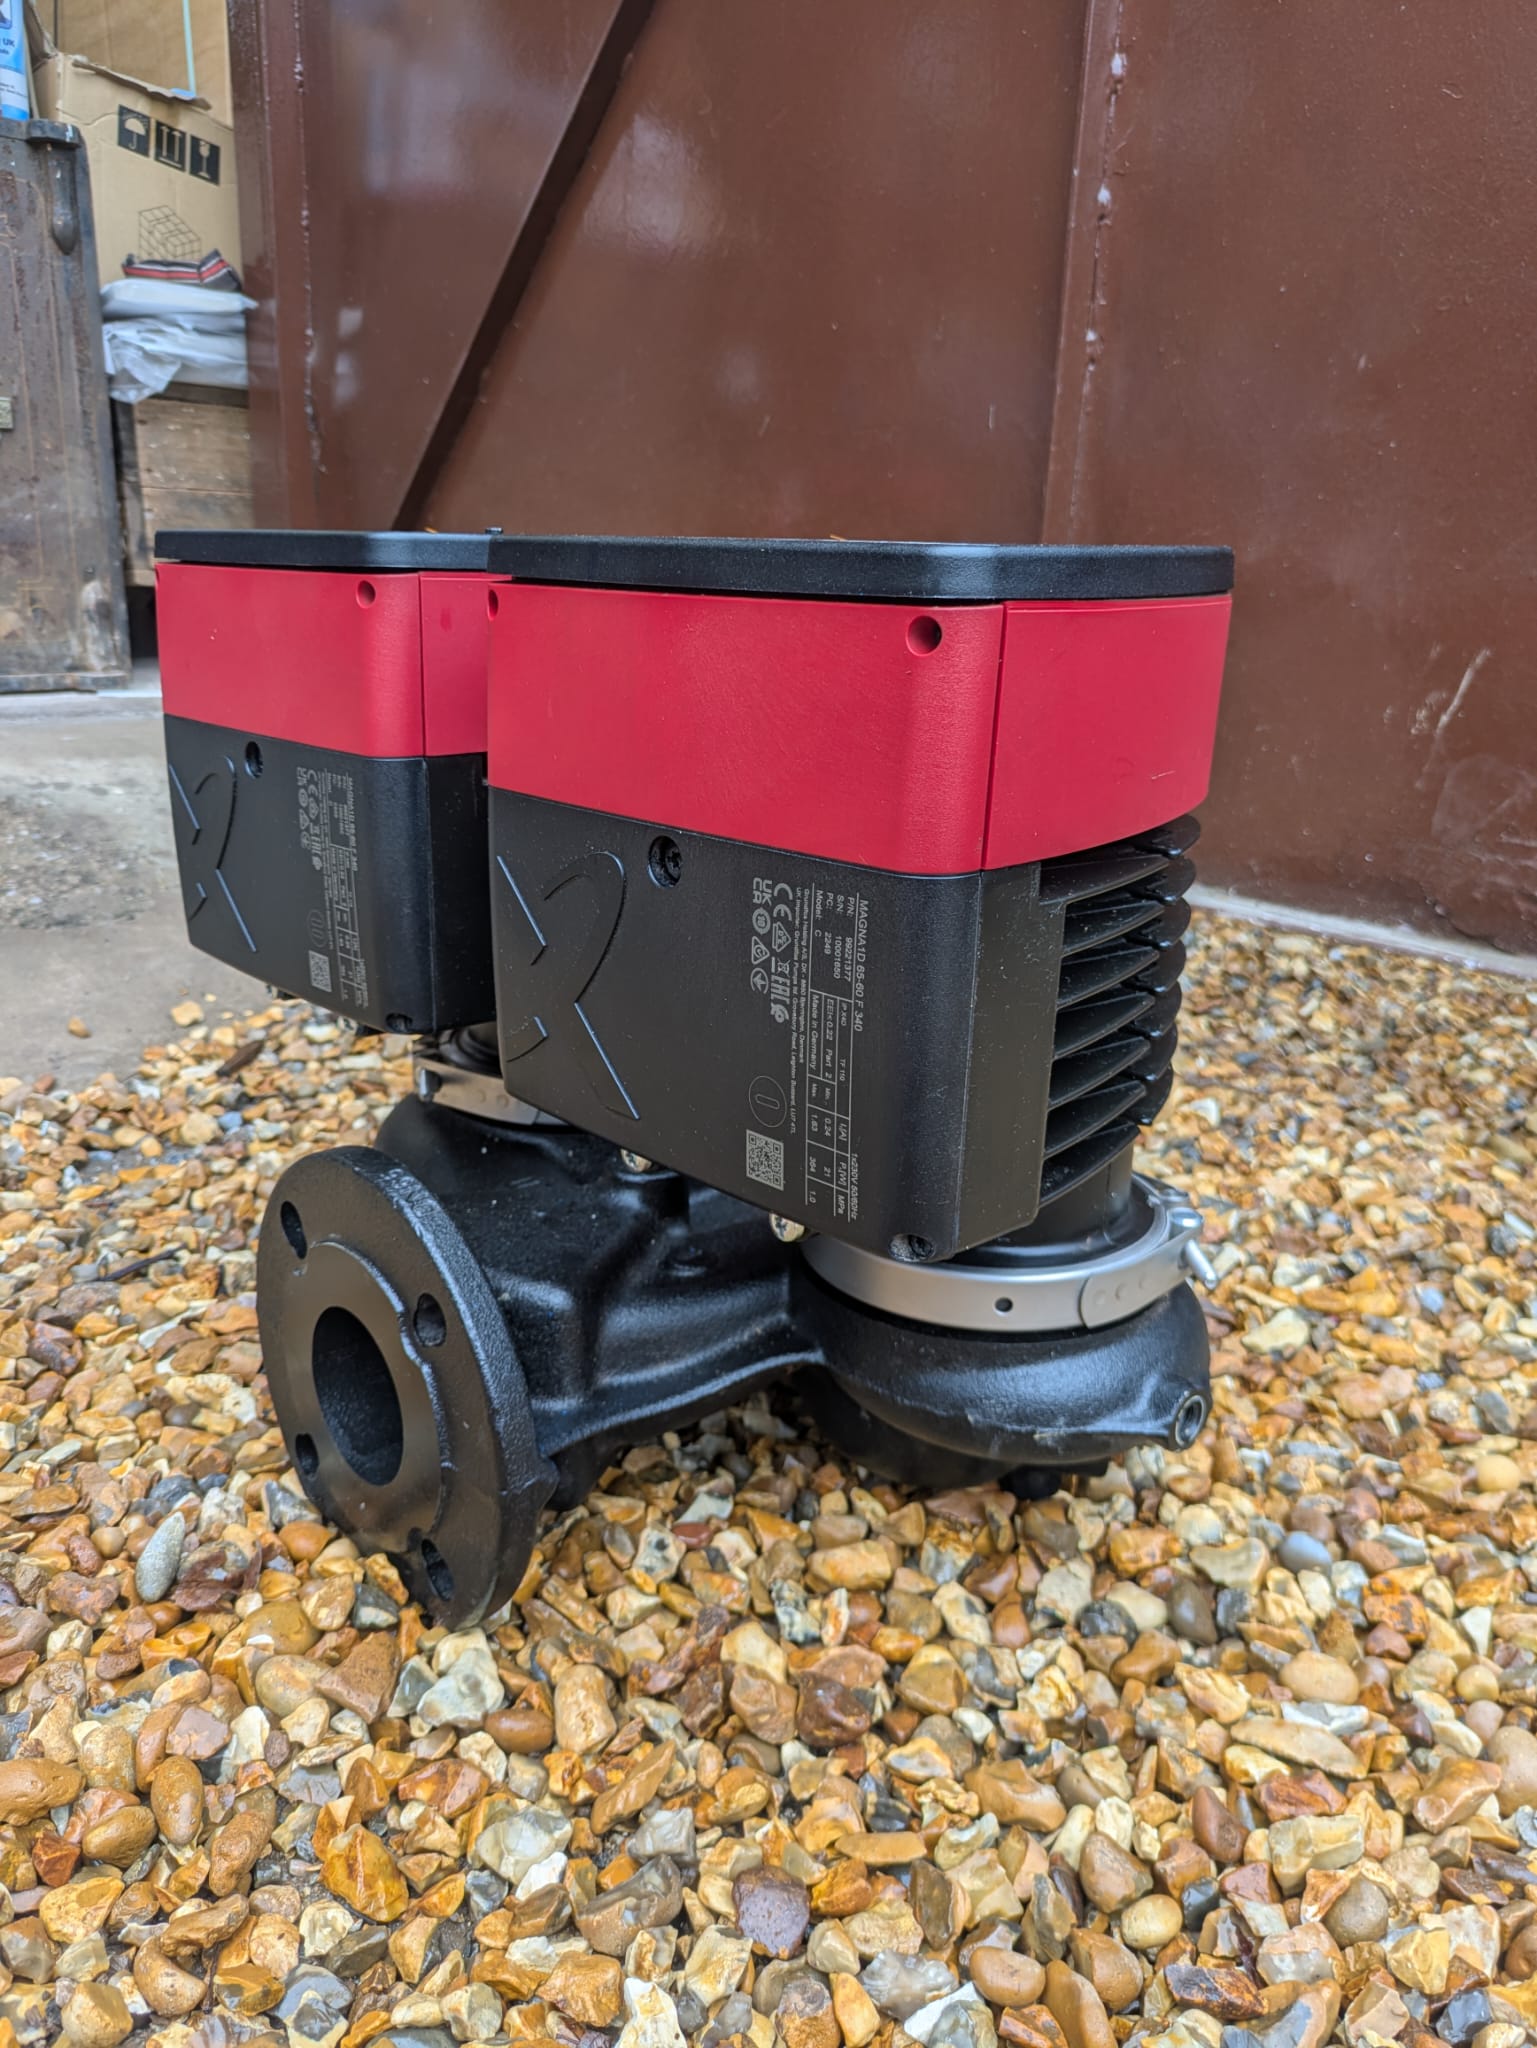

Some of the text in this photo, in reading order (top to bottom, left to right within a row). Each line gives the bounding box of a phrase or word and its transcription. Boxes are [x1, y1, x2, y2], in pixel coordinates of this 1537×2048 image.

[752, 877, 762, 904] CA
[762, 880, 773, 906] UK
[773, 883, 793, 921] CE
[815, 890, 823, 937] Model: C
[824, 892, 834, 955] PC: 2249
[833, 894, 845, 979] S/N: 10001650
[844, 896, 855, 982] P/N: 99221377
[854, 900, 869, 1032] MAGNA1D 65-60 F 340
[810, 994, 820, 1070] Made in Germany
[825, 1049, 833, 1067] Part
[840, 1059, 846, 1069] TF
[809, 1190, 817, 1204] 1.0
[837, 1195, 845, 1214] MPa
